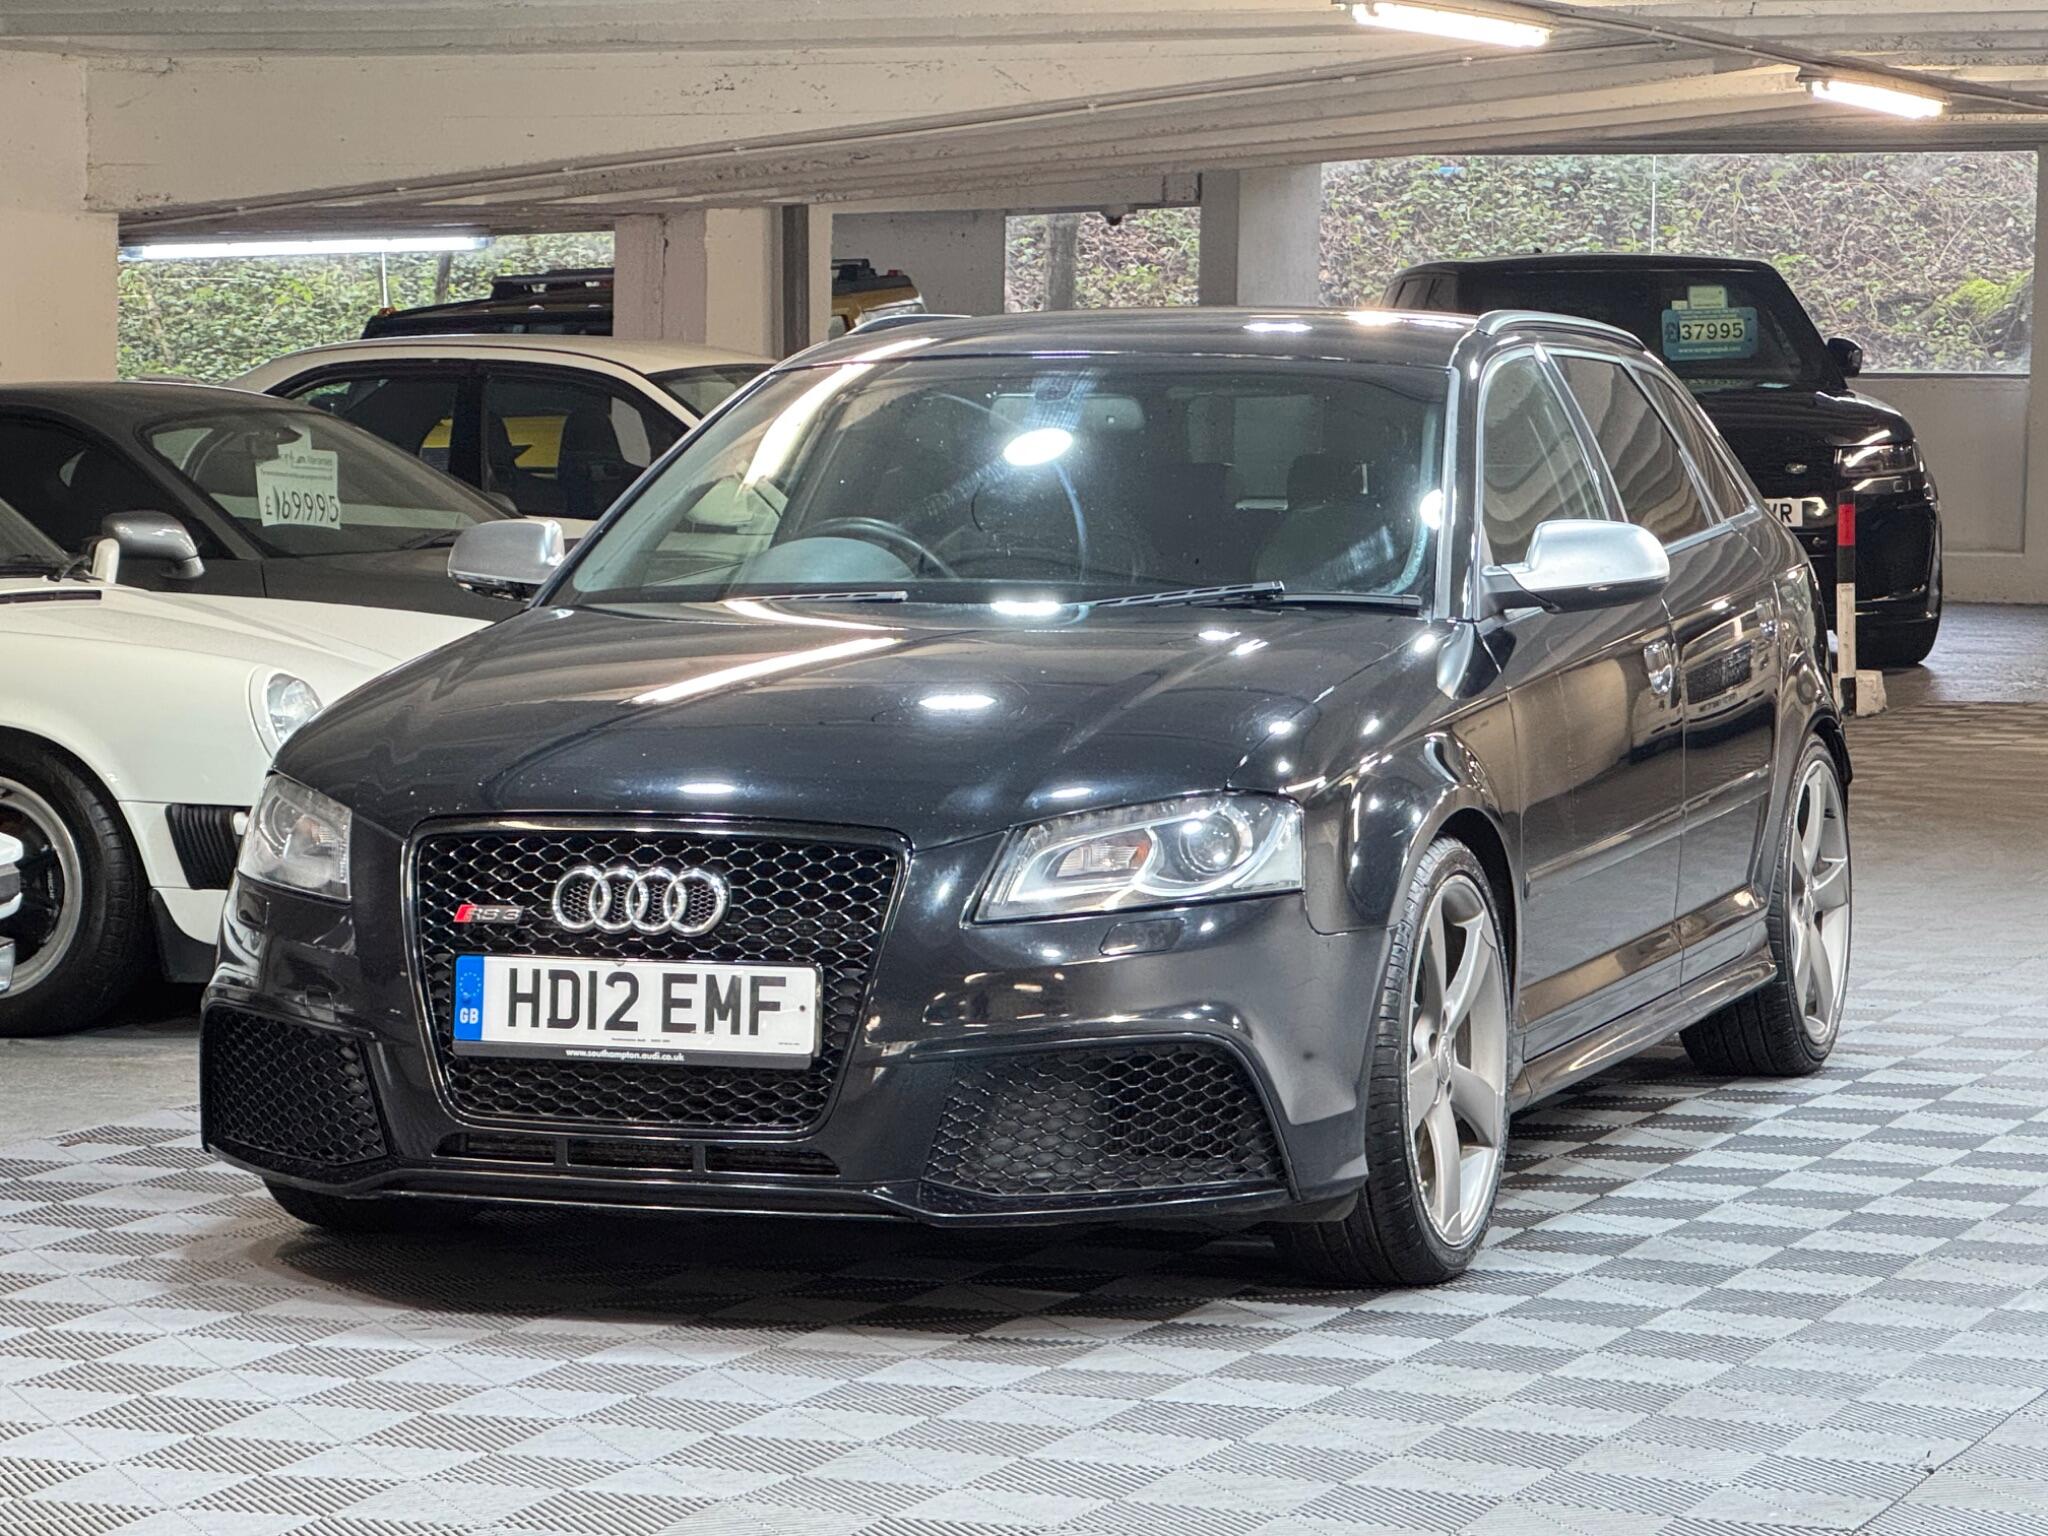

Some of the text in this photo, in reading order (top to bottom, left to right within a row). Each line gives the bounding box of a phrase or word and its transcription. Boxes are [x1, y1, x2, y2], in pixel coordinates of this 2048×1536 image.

[508, 968, 787, 1035] HD12 EMF
[459, 1008, 479, 1024] GB
[565, 1048, 685, 1061] www.southampton.audi.co.uk
